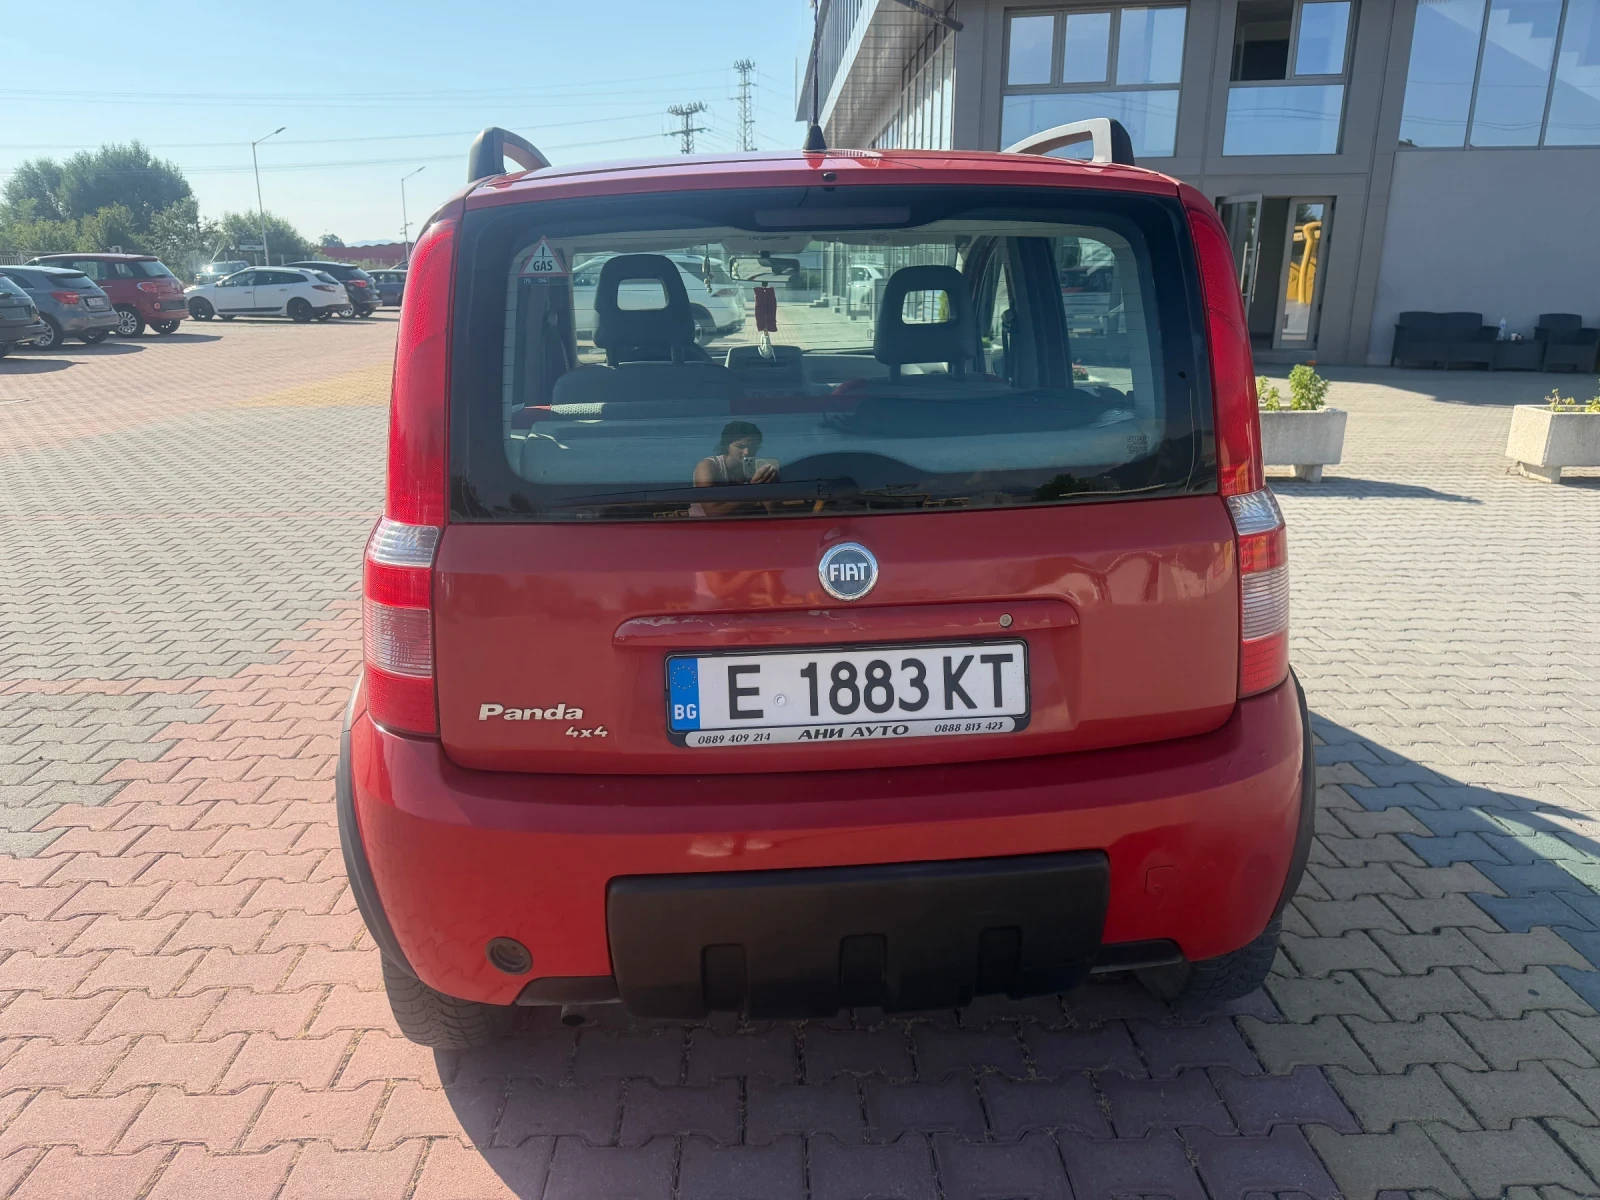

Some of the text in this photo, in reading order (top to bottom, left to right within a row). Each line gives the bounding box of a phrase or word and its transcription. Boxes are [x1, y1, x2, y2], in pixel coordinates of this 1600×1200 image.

[533, 260, 553, 271] GAS
[829, 562, 868, 582] FIAT
[728, 653, 1014, 720] E 1883 KT
[478, 703, 584, 721] Panda
[674, 703, 697, 720] BG
[565, 725, 609, 738] 4x4
[798, 724, 910, 740] АНИ АУТО
[934, 721, 1004, 733] 0888 813 423
[697, 732, 771, 745] 0889 409 214
